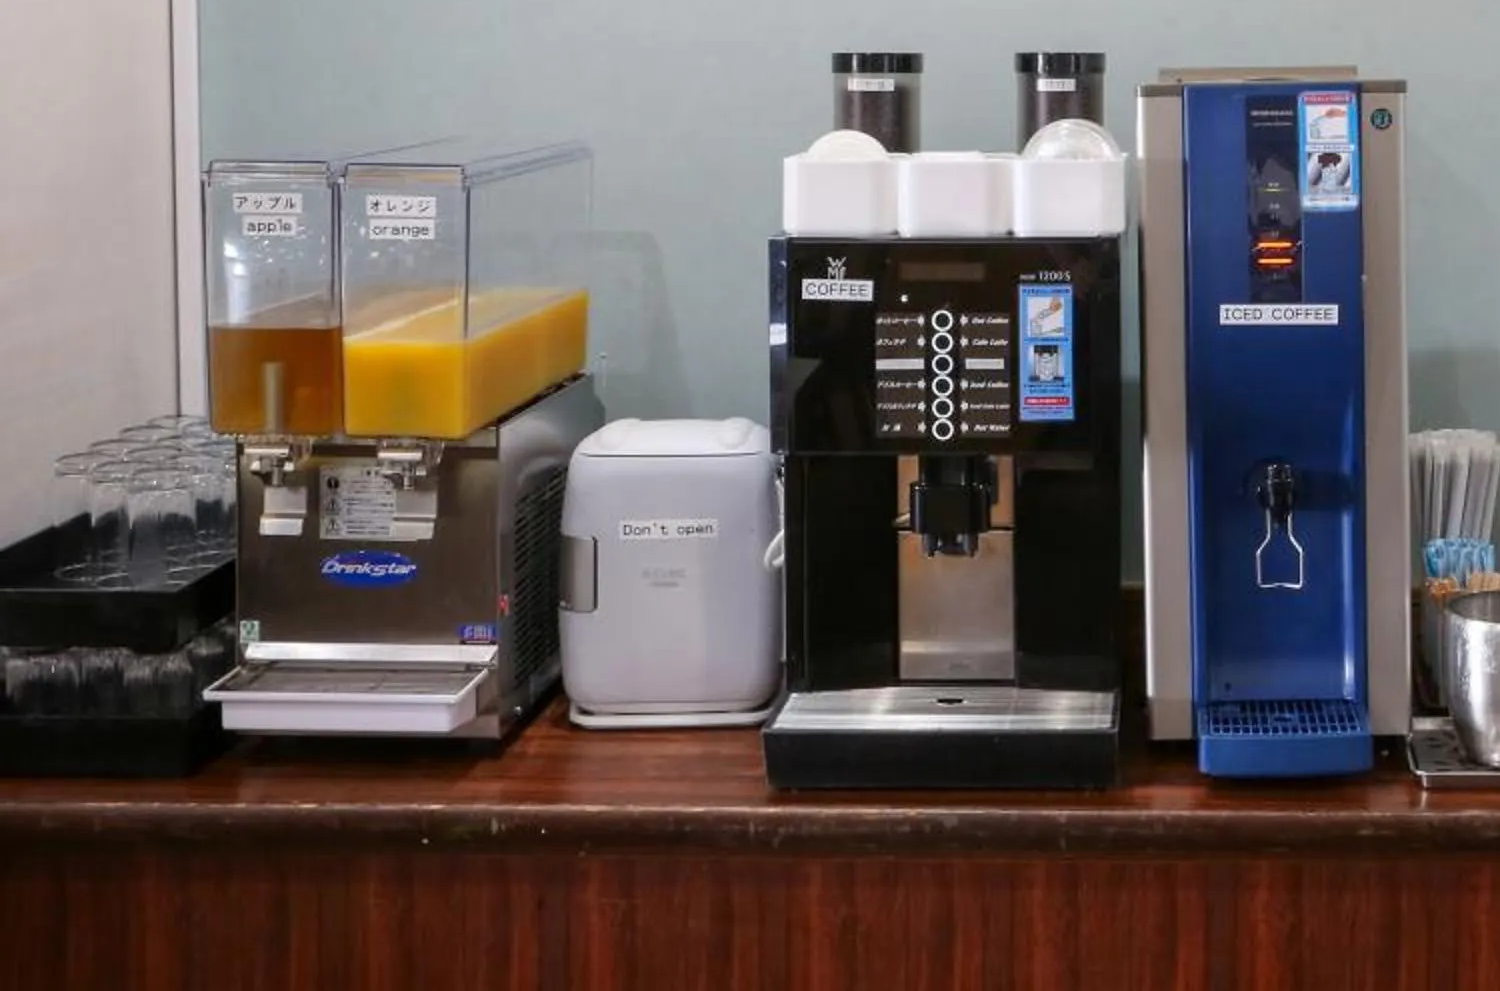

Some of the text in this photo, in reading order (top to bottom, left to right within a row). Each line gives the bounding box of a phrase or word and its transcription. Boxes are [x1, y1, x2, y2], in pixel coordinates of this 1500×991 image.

[235, 196, 296, 210] アップル
[370, 200, 430, 213] オレンジ
[247, 219, 293, 233] apple
[371, 223, 430, 238] orange
[805, 282, 870, 297] COFFEE
[1224, 308, 1333, 321] ICED COFFEE
[623, 522, 713, 536] Don't open
[321, 559, 417, 576] Drinkstar
